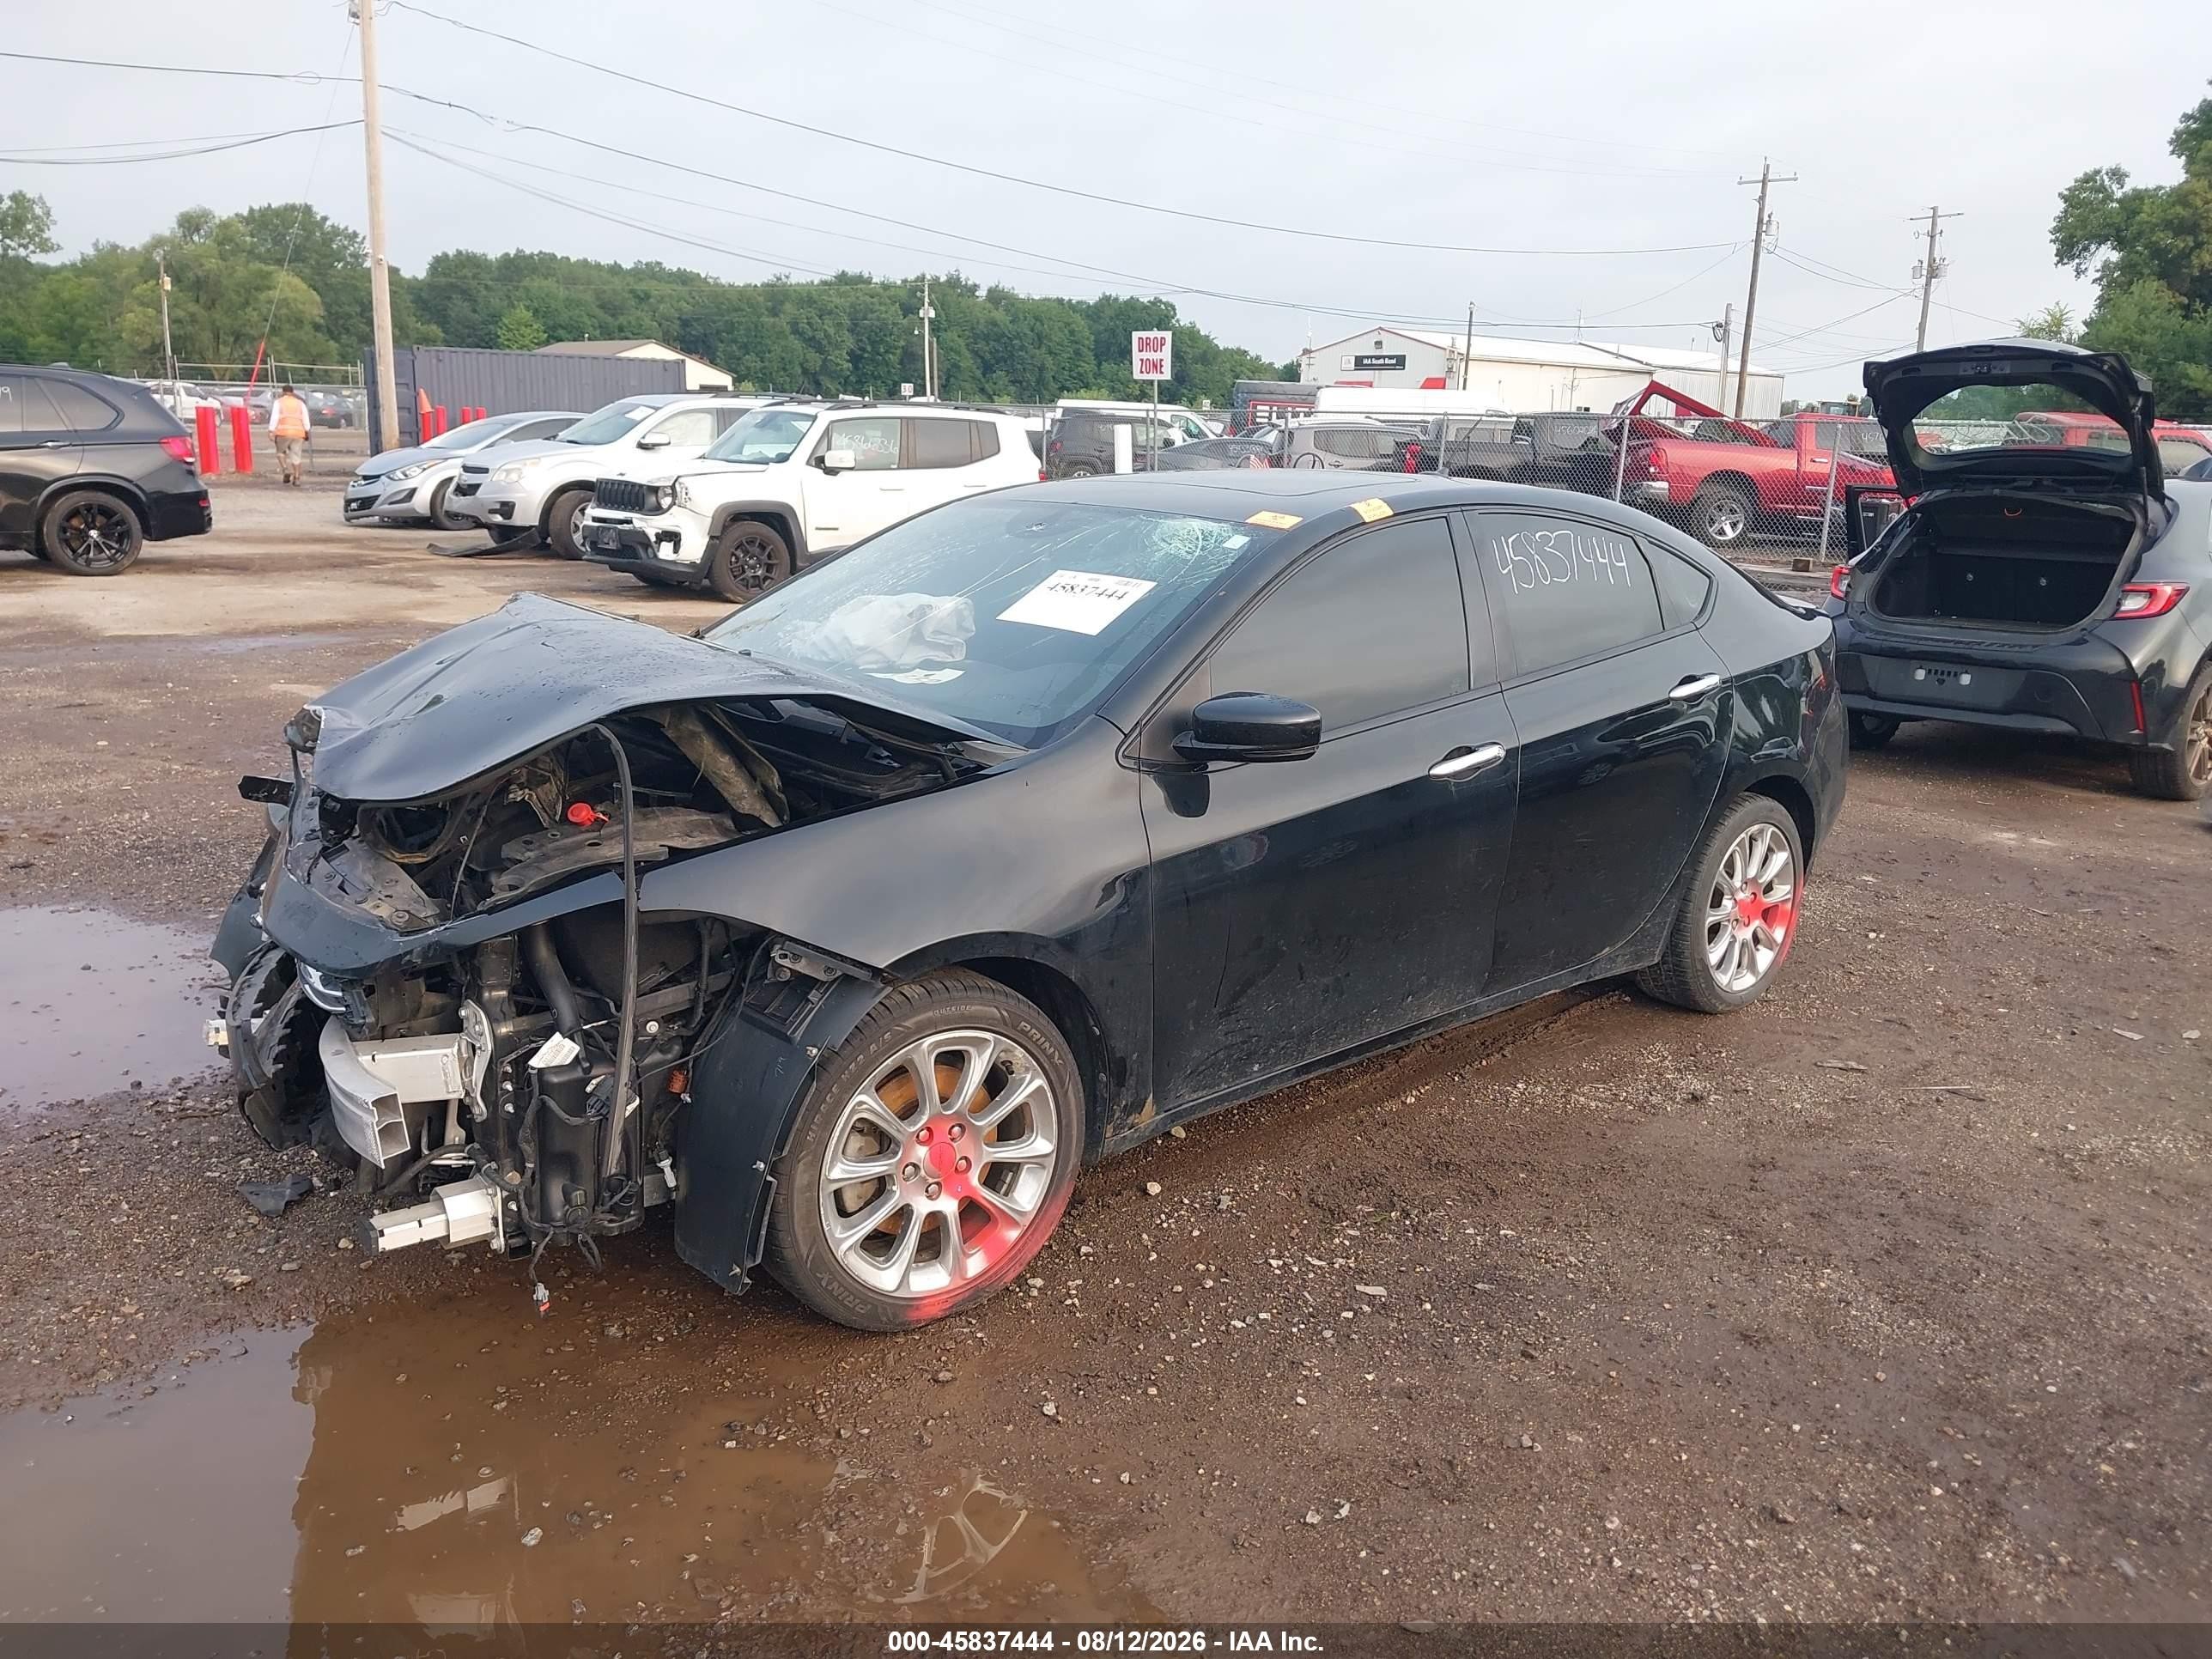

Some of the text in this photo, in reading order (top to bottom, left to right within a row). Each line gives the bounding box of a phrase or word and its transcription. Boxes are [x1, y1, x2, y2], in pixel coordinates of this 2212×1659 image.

[1137, 336, 1166, 353] DROP
[1139, 357, 1164, 374] ZONE
[1492, 530, 1632, 595] 45837444
[1046, 581, 1129, 600] 45837444
[1016, 1020, 1065, 1066] PRINX
[816, 1271, 872, 1314] PRINX
